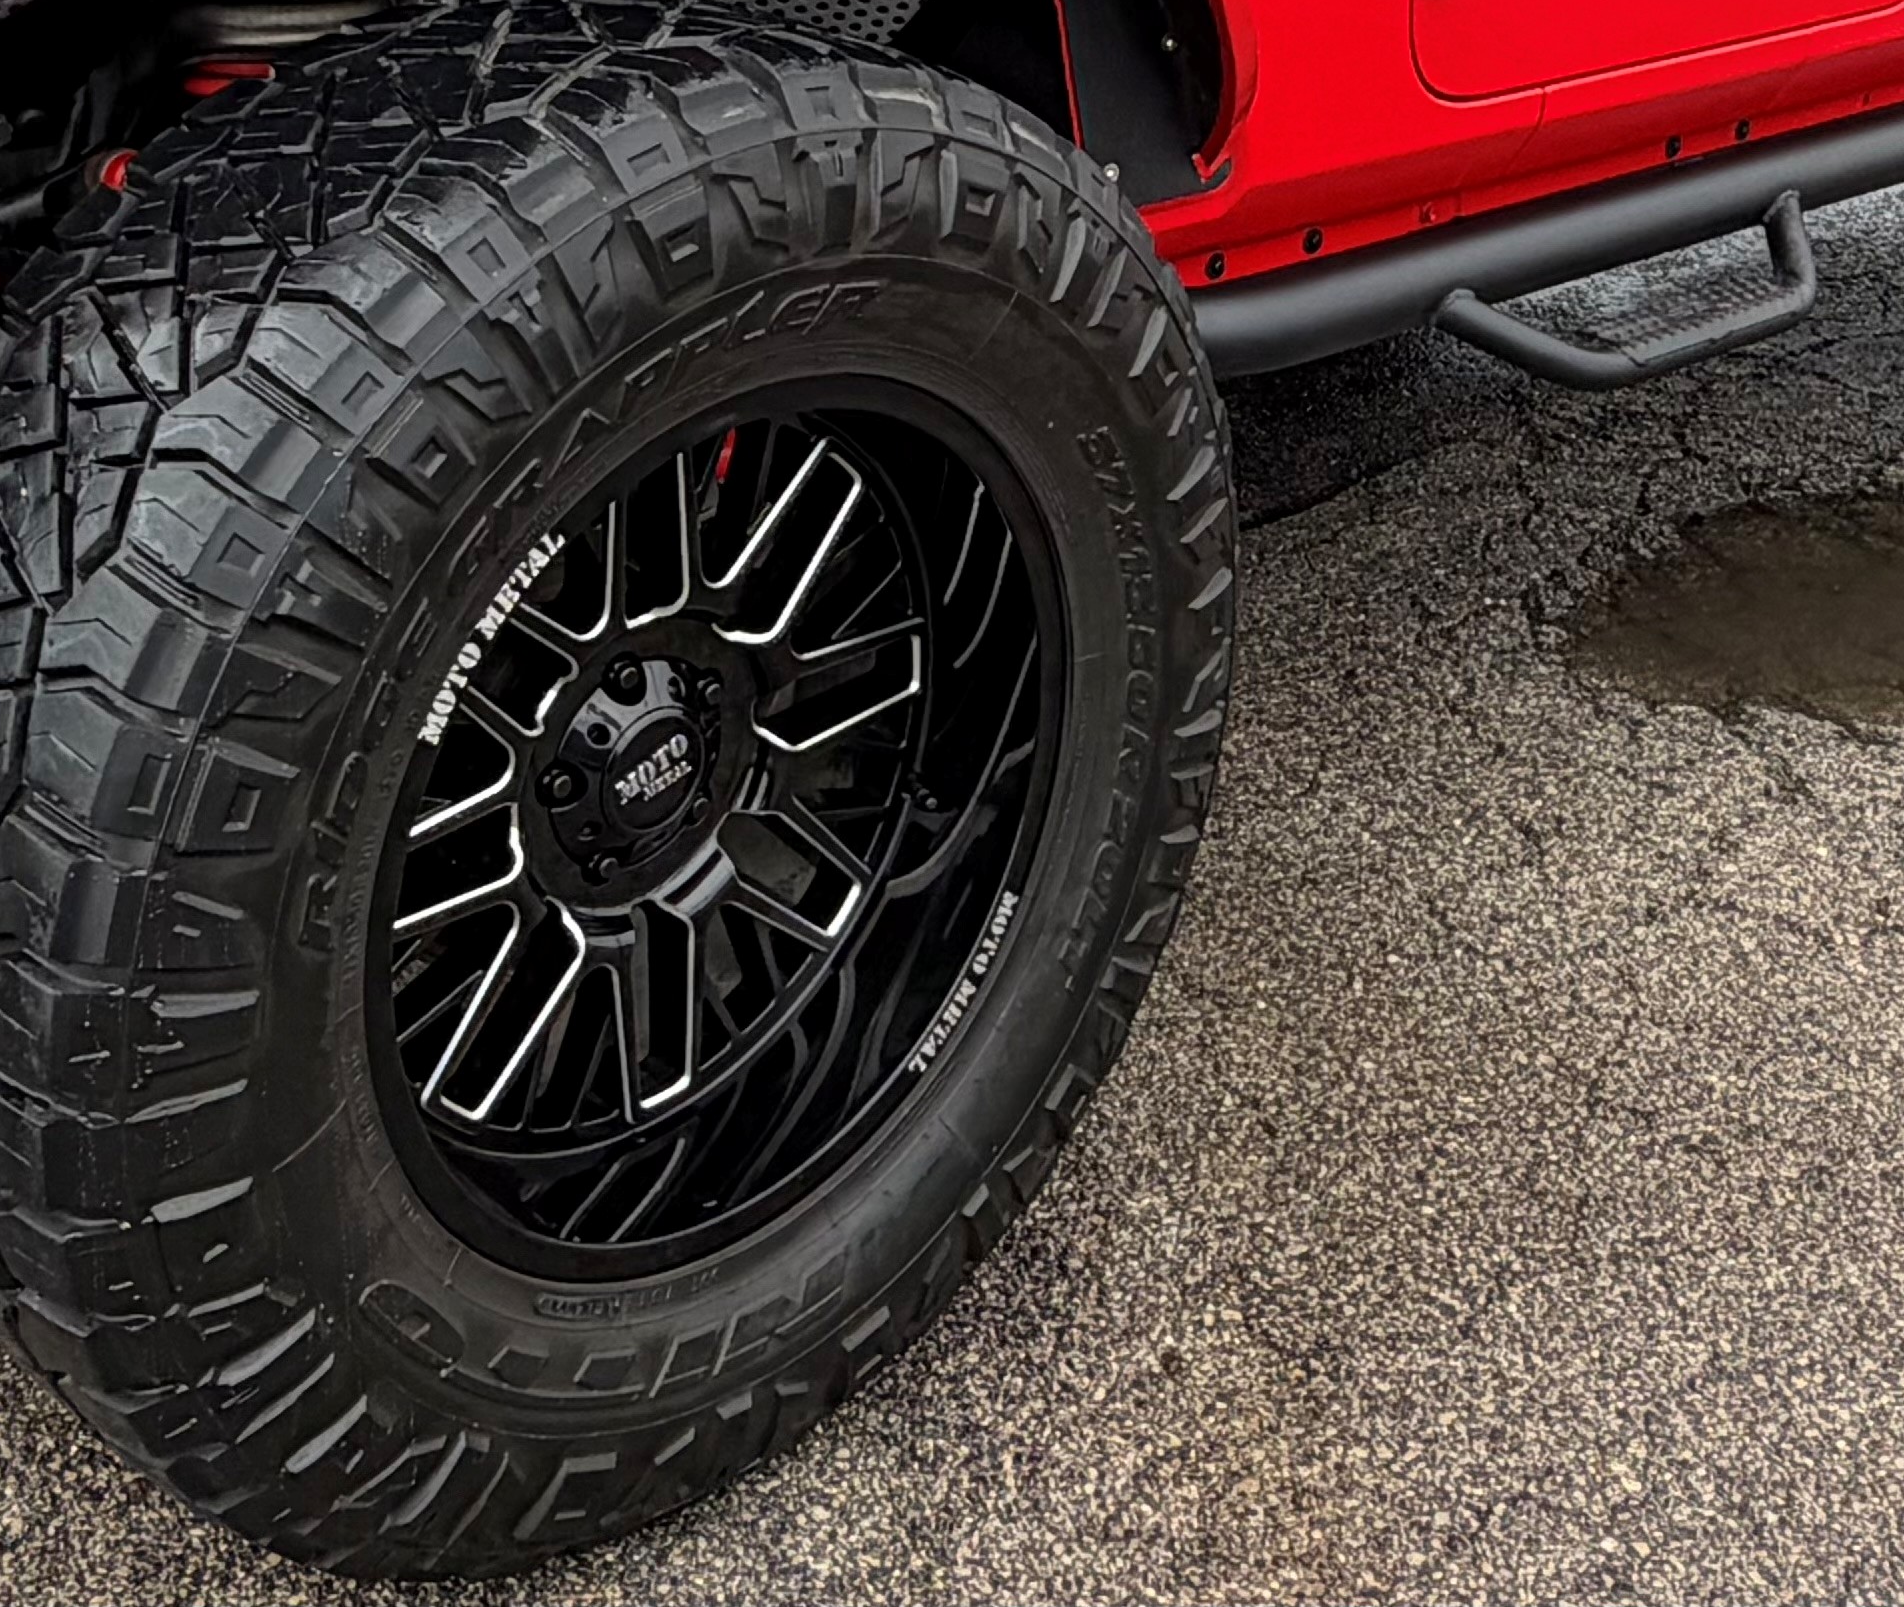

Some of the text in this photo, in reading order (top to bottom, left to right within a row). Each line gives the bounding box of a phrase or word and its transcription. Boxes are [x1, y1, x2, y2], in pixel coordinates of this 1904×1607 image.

[416, 532, 567, 746] MOTO METAL
[615, 733, 689, 805] MOTO
[642, 760, 693, 802] METAL
[908, 890, 1020, 1073] MOTO METAL
